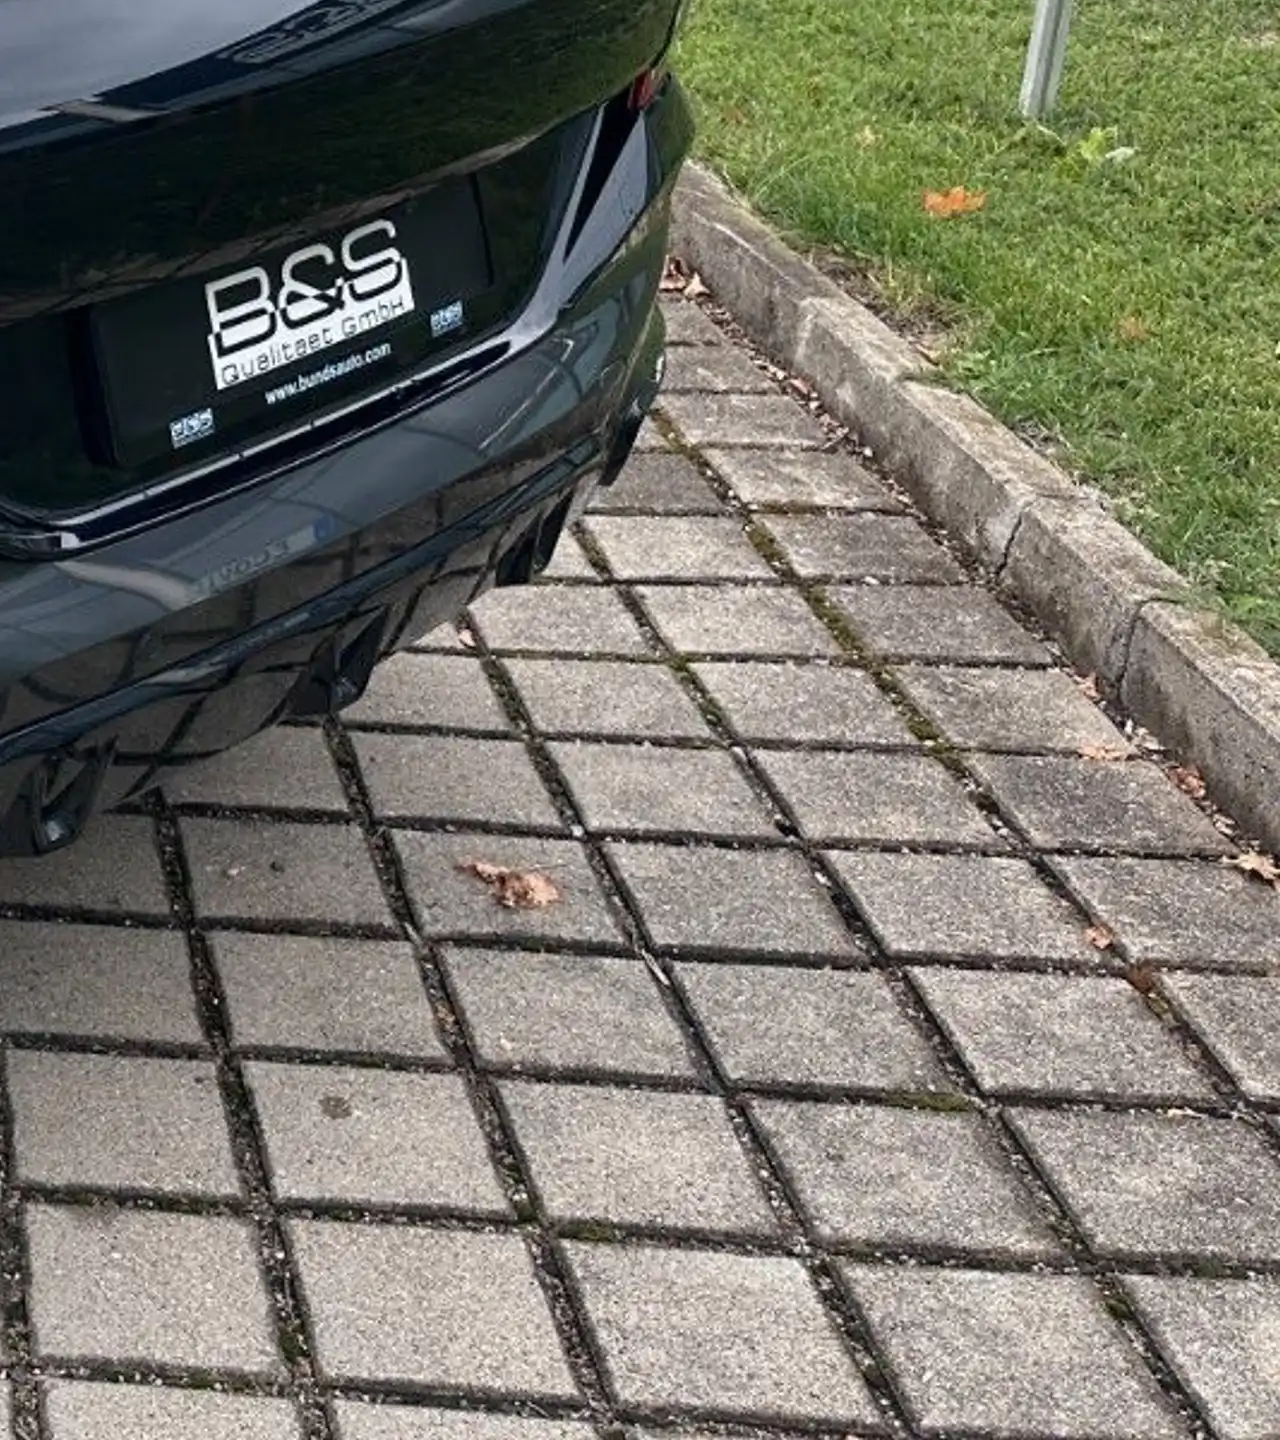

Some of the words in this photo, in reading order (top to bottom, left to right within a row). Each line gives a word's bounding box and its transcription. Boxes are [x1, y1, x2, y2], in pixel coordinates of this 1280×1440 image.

[205, 219, 403, 358] B&S
[220, 327, 334, 386] Qualitaet
[341, 295, 406, 338] GmbH
[264, 342, 392, 404] www.bundsauto.com
